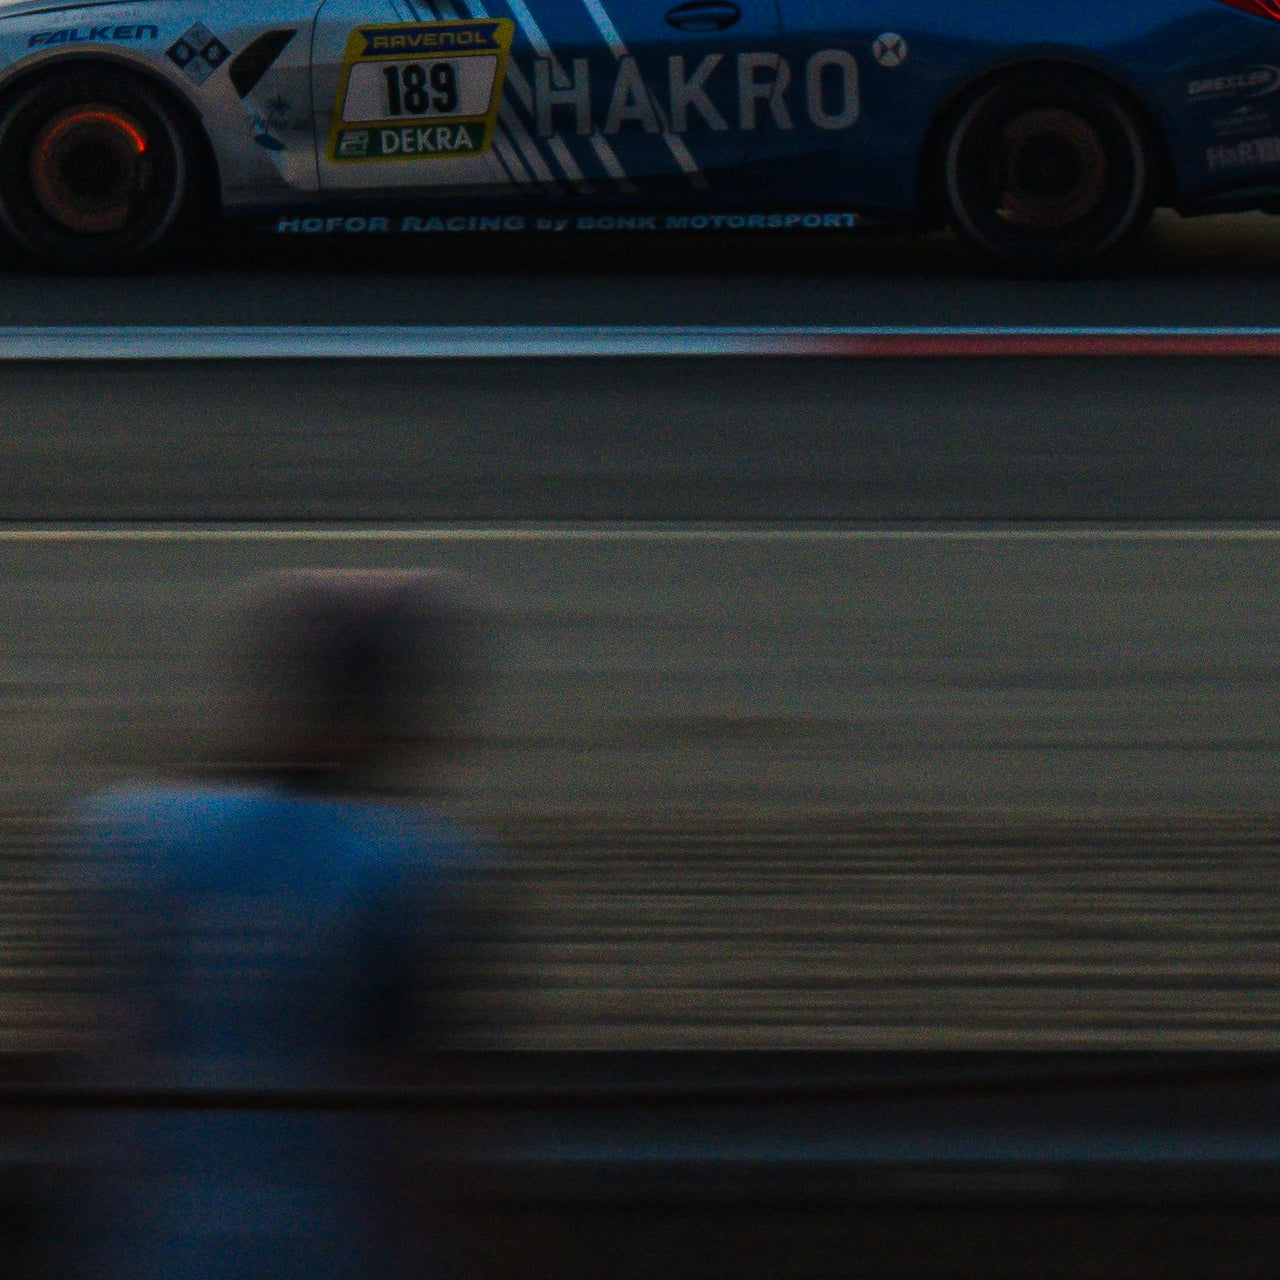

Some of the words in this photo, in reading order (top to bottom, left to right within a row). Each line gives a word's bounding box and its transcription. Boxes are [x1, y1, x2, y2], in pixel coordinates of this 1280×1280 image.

[27, 23, 159, 48] FALKEN
[373, 30, 488, 49] RAVENOL
[382, 62, 458, 116] 189
[533, 48, 861, 138] HAKRO
[380, 124, 473, 155] DEKRA
[275, 215, 390, 233] HOFOR
[400, 214, 526, 233] RACING
[534, 216, 569, 233] by
[575, 215, 658, 230] BONK
[665, 212, 860, 230] MOTORSPORT
